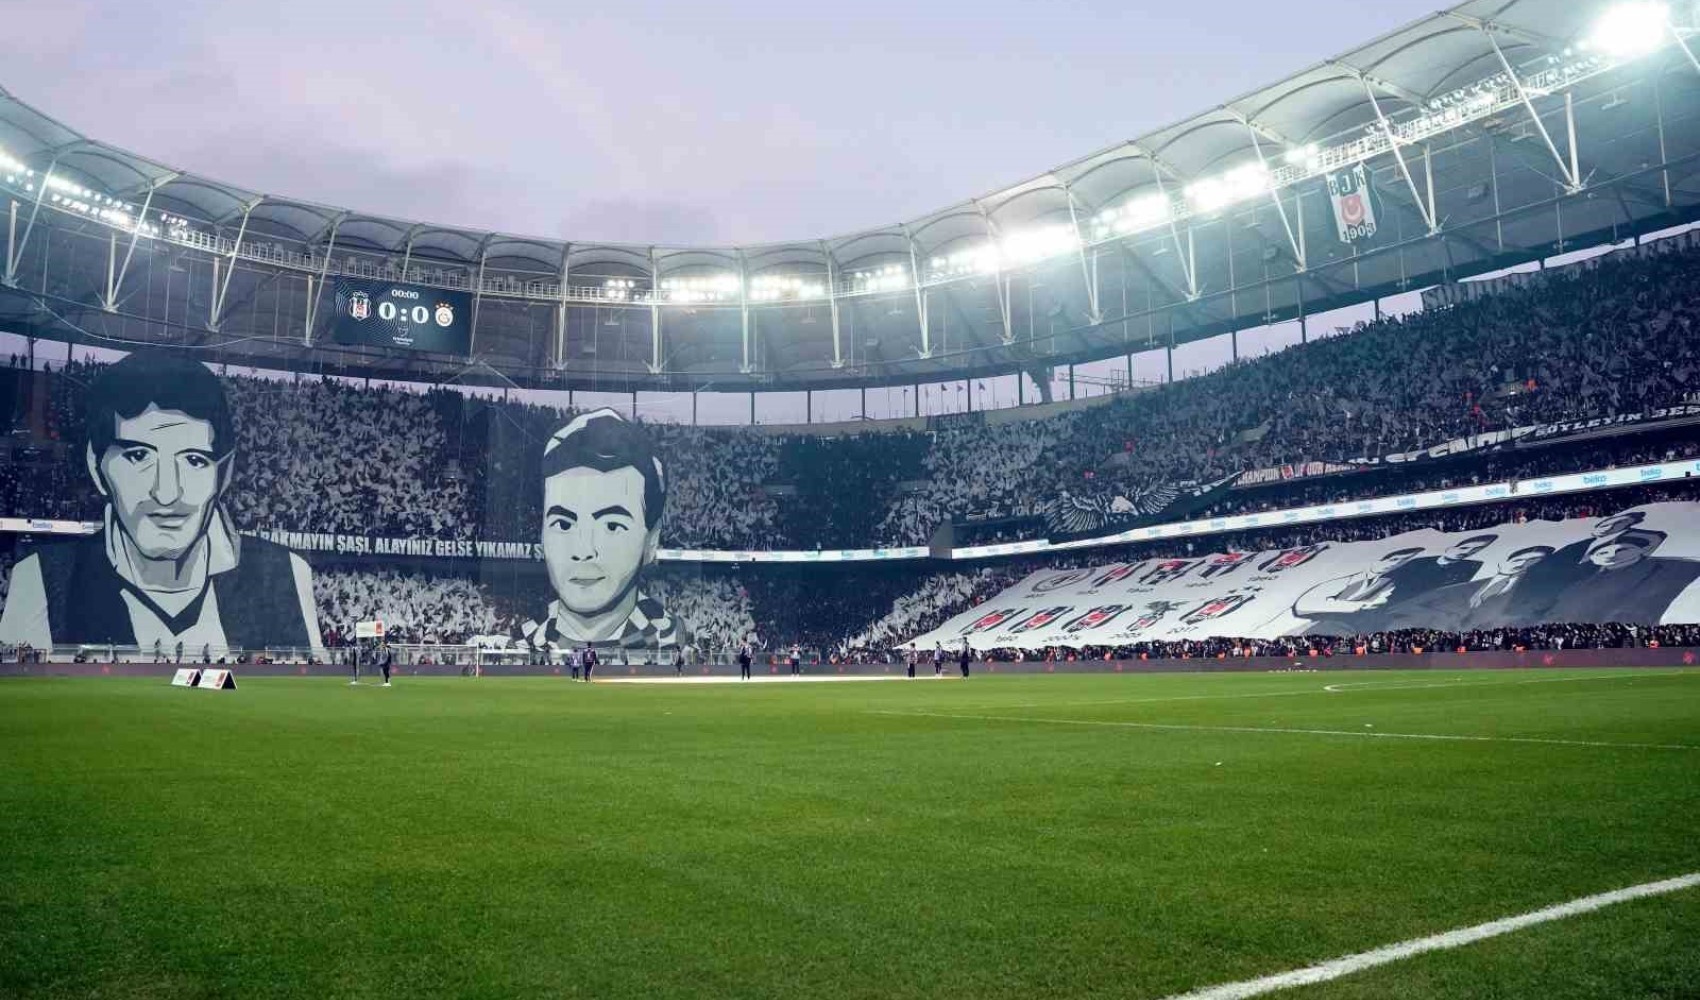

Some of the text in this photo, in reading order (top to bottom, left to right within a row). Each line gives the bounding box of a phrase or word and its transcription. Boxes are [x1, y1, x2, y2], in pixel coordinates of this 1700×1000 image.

[1328, 171, 1366, 197] BJK
[391, 289, 419, 299] 00:00
[379, 302, 429, 323] 0:0
[375, 537, 433, 556] ALAYINIZ
[435, 540, 473, 557] GELSE
[475, 541, 532, 559] YIKAMAZ
